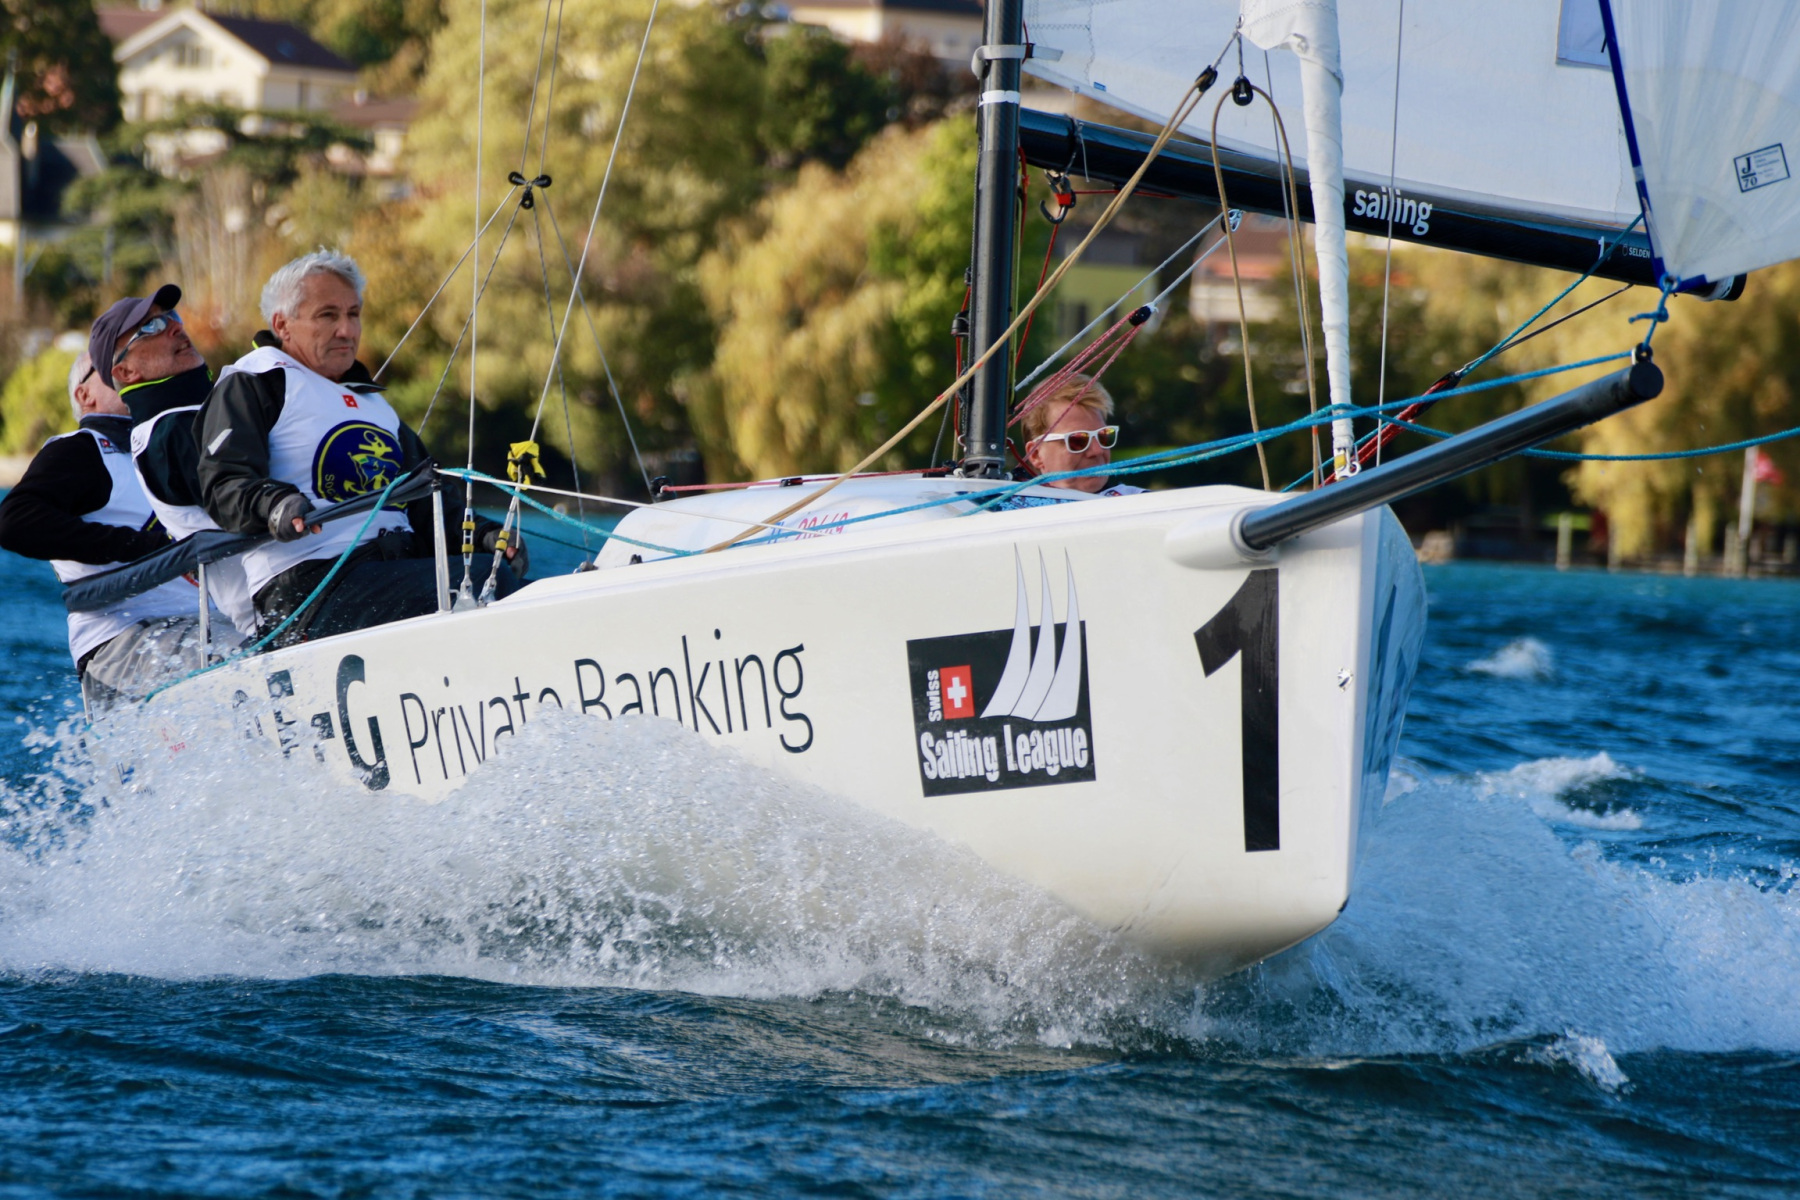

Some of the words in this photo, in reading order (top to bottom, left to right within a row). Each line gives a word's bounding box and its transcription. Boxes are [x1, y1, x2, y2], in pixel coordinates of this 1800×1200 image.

[1743, 176, 1758, 189] 70
[1352, 185, 1433, 236] sailing
[1193, 567, 1281, 853] 1
[920, 729, 1000, 782] Sailing
[1002, 724, 1090, 777] League
